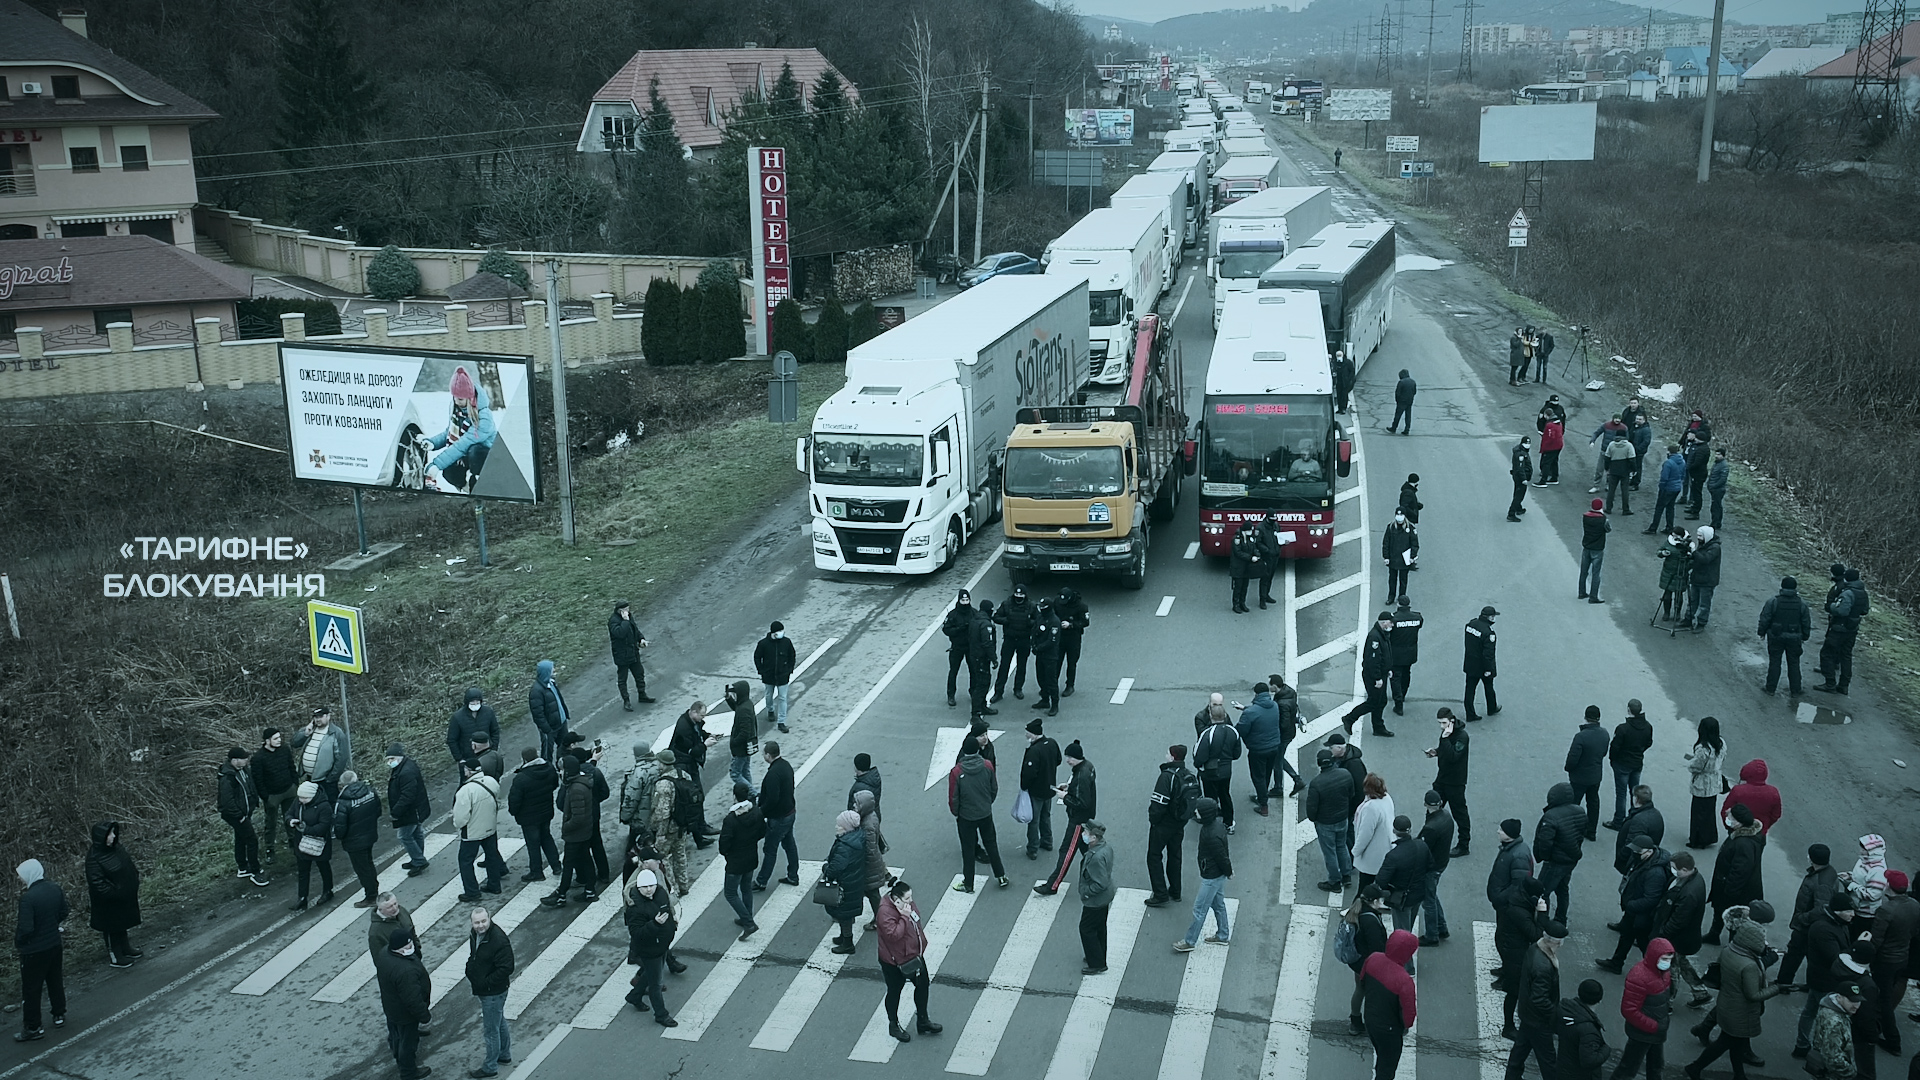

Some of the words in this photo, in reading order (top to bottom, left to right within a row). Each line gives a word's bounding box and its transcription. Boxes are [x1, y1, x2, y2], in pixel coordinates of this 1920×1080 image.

[762, 151, 783, 264] HOTEL
[299, 368, 351, 385] ОЖЕЛЕДИЦЯ
[353, 372, 366, 386] НА
[368, 373, 403, 388] ДОРОЗІ?
[301, 390, 345, 406] ЗАХОПІТЬ
[347, 394, 393, 410] ЛАНЦЮГИ
[304, 412, 333, 427] ПРОТИ
[334, 415, 382, 431] КОВЗАННЯ
[850, 508, 885, 517] MAN
[1227, 513, 1241, 522] TR
